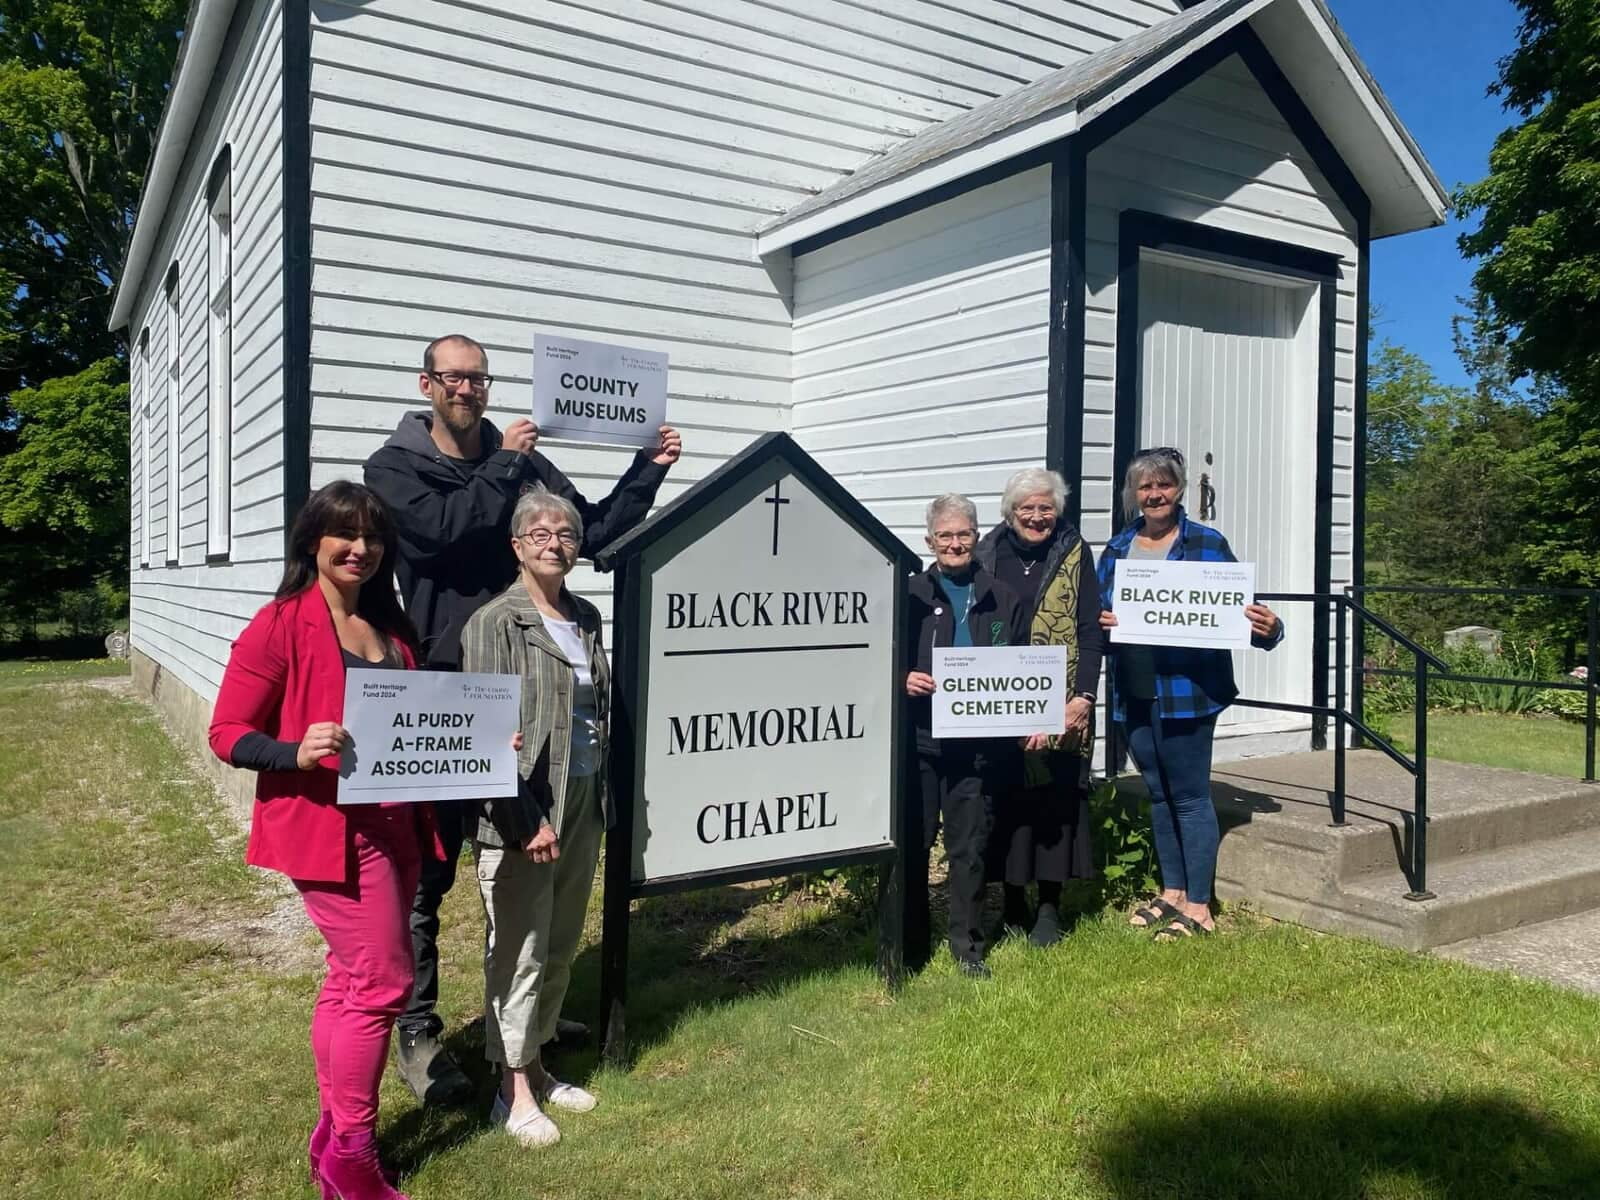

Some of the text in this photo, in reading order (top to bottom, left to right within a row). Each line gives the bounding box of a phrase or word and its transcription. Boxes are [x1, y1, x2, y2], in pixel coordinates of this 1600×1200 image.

[560, 372, 639, 398] COUNTY
[554, 397, 646, 424] MUSEUMS
[1120, 587, 1245, 607] BLACK RIVER
[665, 591, 869, 629] BLACK RIVER
[1143, 610, 1219, 628] CHAPEL
[379, 684, 407, 692] Heritage
[943, 676, 1052, 692] GLENWOOD
[951, 699, 1048, 715] CEMETERY
[392, 713, 475, 728] AL PURDY
[666, 704, 865, 756] MEMORIAL
[391, 736, 473, 752] A-FRAME
[370, 758, 492, 776] ASSOCIATION
[696, 792, 838, 844] CHAPEL
